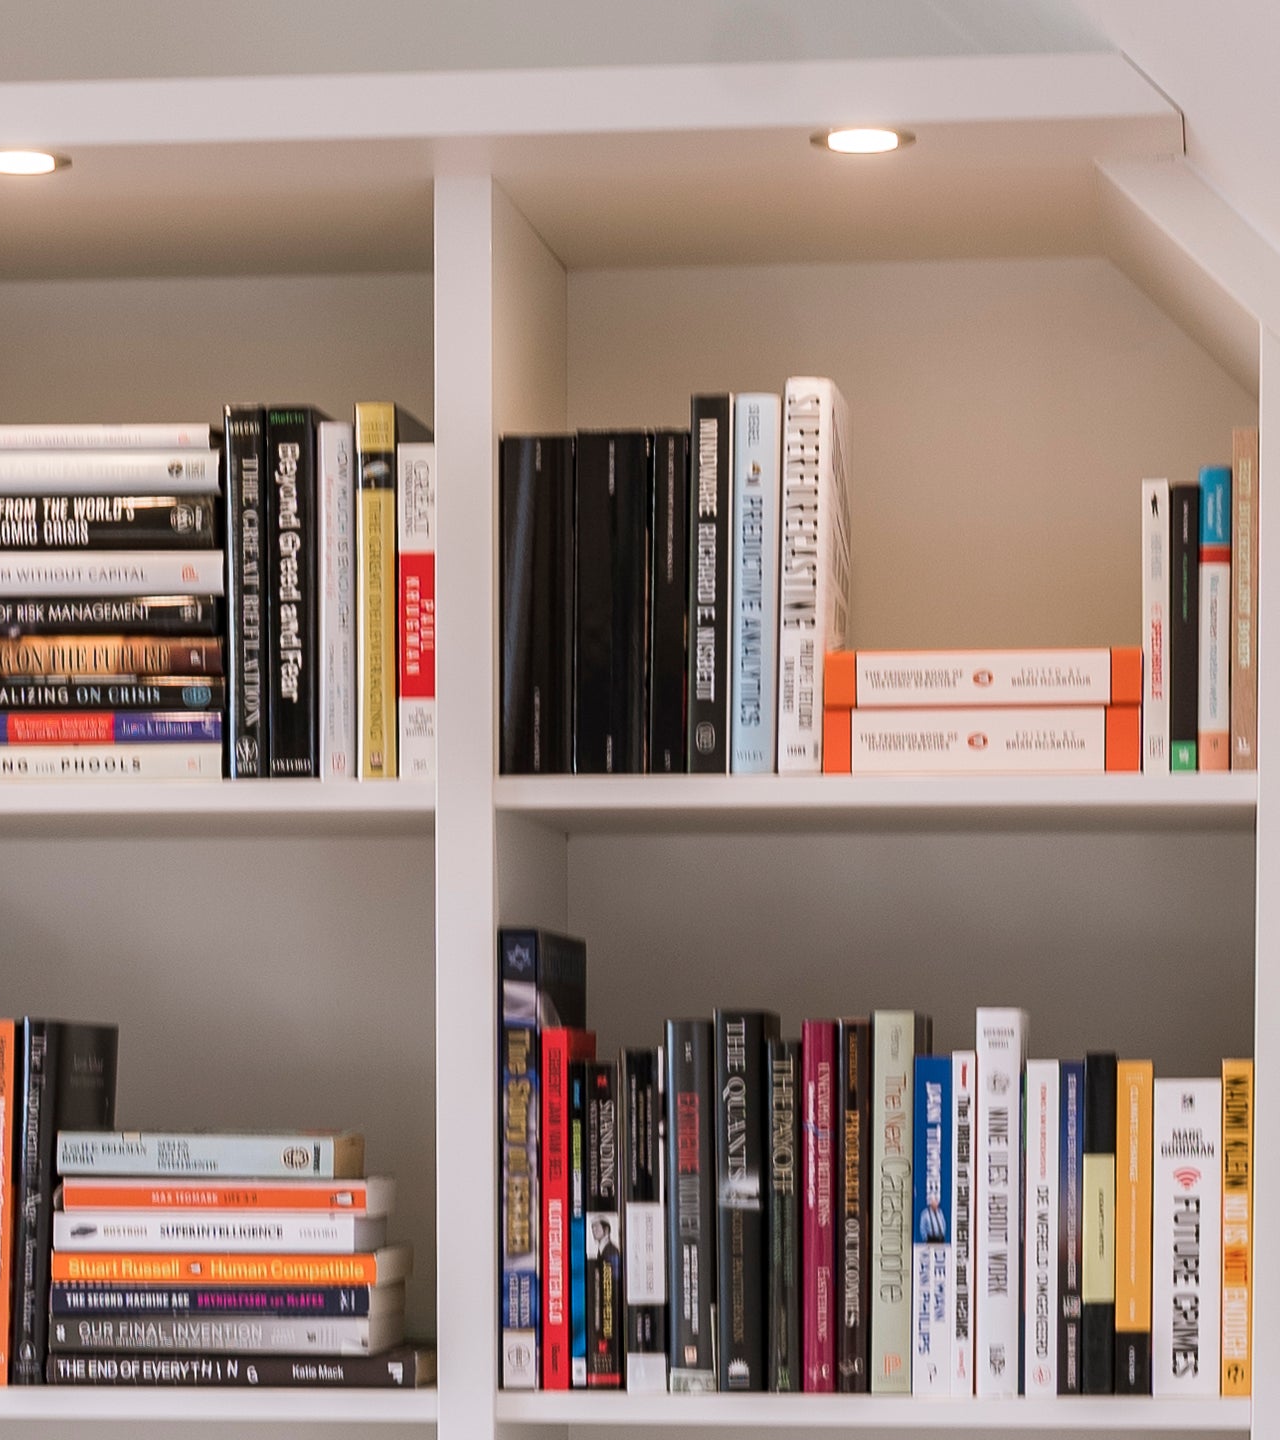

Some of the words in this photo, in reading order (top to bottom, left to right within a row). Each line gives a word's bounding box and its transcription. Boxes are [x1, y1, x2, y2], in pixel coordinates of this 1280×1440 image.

[242, 454, 260, 506] THE
[274, 442, 301, 529] Beyond
[43, 497, 68, 521] THE
[74, 497, 135, 521] WORLD'S
[43, 520, 89, 545] CRISIS
[16, 563, 83, 582] WITHOUT
[88, 563, 148, 582] CAPITAL
[242, 510, 260, 585] GREAT
[278, 532, 302, 601] Greed
[741, 494, 763, 611] PREDICTIVE
[17, 604, 44, 622] RISK
[48, 603, 151, 621] MANAGEMENT
[279, 604, 302, 650] and
[406, 575, 420, 676] KRUGMAN
[420, 599, 434, 652] PAUL
[16, 645, 43, 673] ON
[50, 645, 87, 672] THE
[93, 645, 170, 672] FUTURE
[243, 595, 260, 727] REFLATION
[280, 651, 303, 703] Fear
[740, 615, 763, 728] ANALYTICS
[76, 687, 99, 705] ON
[109, 686, 160, 703] CRISIS
[725, 1017, 746, 1073] THE
[988, 1106, 1009, 1146] NINE
[1225, 1075, 1248, 1130] NAOMI
[599, 1099, 614, 1198] STANDING
[723, 1076, 746, 1180] QUANTS
[1161, 1144, 1215, 1159] GOODMAN
[1172, 1128, 1202, 1141] MARC
[845, 1110, 860, 1213] PROBABLE
[988, 1151, 1009, 1188] LIES
[1225, 1137, 1248, 1192] KLEIN
[159, 1223, 284, 1240] SUPERINTELLIGENCE
[988, 1191, 1009, 1245] ABOUT
[1225, 1194, 1248, 1223] NO
[1173, 1196, 1200, 1288] FUTURE
[1225, 1224, 1248, 1247] IS
[68, 1259, 117, 1277] Stuart
[122, 1259, 179, 1277] Russell
[211, 1259, 267, 1277] Human
[271, 1259, 364, 1281] Compatible
[844, 1217, 860, 1328] OUTCOMES
[988, 1249, 1009, 1298] WORK
[1225, 1248, 1248, 1285] NOT
[66, 1292, 85, 1307] THE
[88, 1292, 123, 1307] SECOND
[126, 1292, 168, 1307] MACHINE
[171, 1292, 189, 1307] AGE
[1225, 1287, 1248, 1360] ENOUGH
[79, 1321, 113, 1339] OUR
[119, 1321, 165, 1339] FINAL
[173, 1322, 263, 1341] INVENTION
[1173, 1292, 1199, 1379] CRIMES
[58, 1360, 86, 1379] THE
[88, 1360, 117, 1379] END
[121, 1360, 139, 1379] OF
[292, 1364, 316, 1379] Katie
[318, 1365, 344, 1380] Mack
